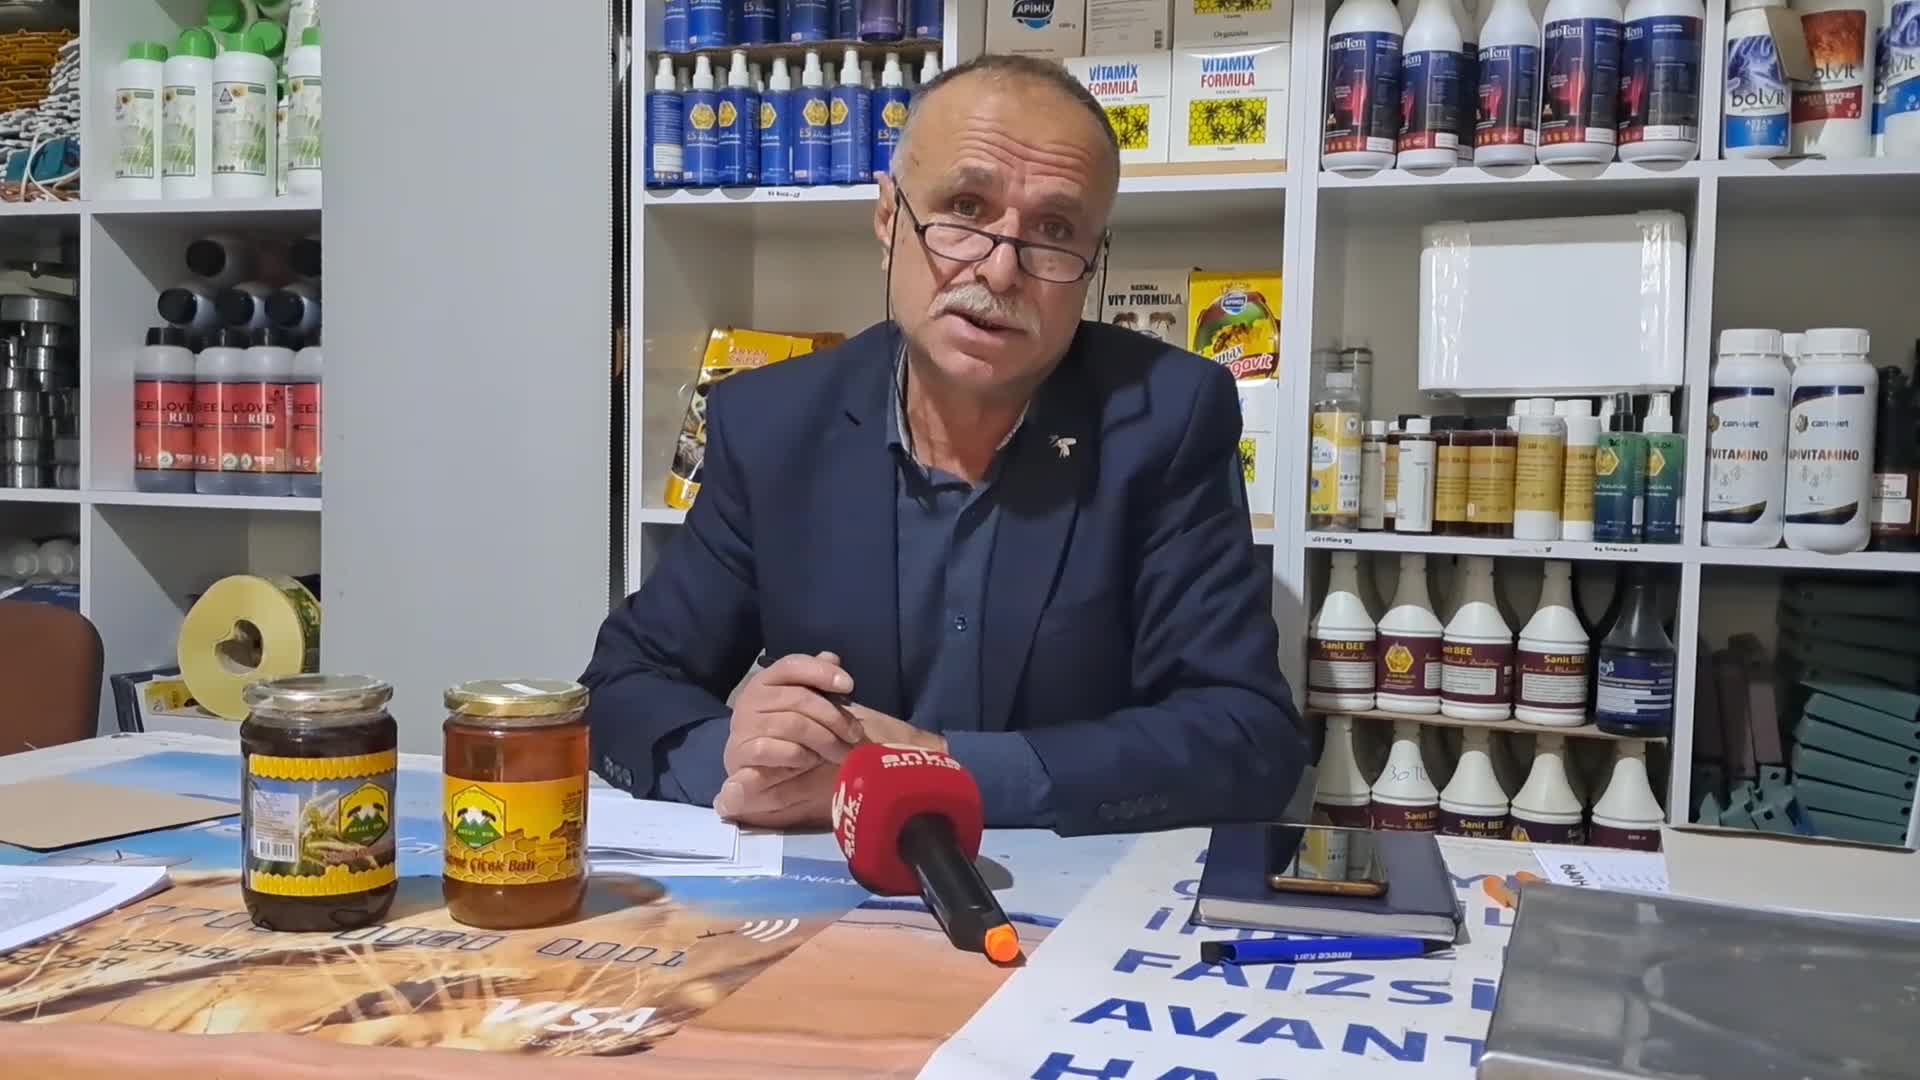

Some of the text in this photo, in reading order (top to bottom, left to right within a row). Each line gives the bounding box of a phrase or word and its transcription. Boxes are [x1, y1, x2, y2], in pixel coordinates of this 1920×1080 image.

[1201, 73, 1256, 88] FORMULA
[1812, 64, 1855, 82] olvit
[1088, 82, 1139, 97] FORMULA
[1129, 293, 1183, 306] FORMULA
[1231, 355, 1273, 376] gavit
[1711, 448, 1769, 462] VITAMINO
[1391, 765, 1409, 780] 30
